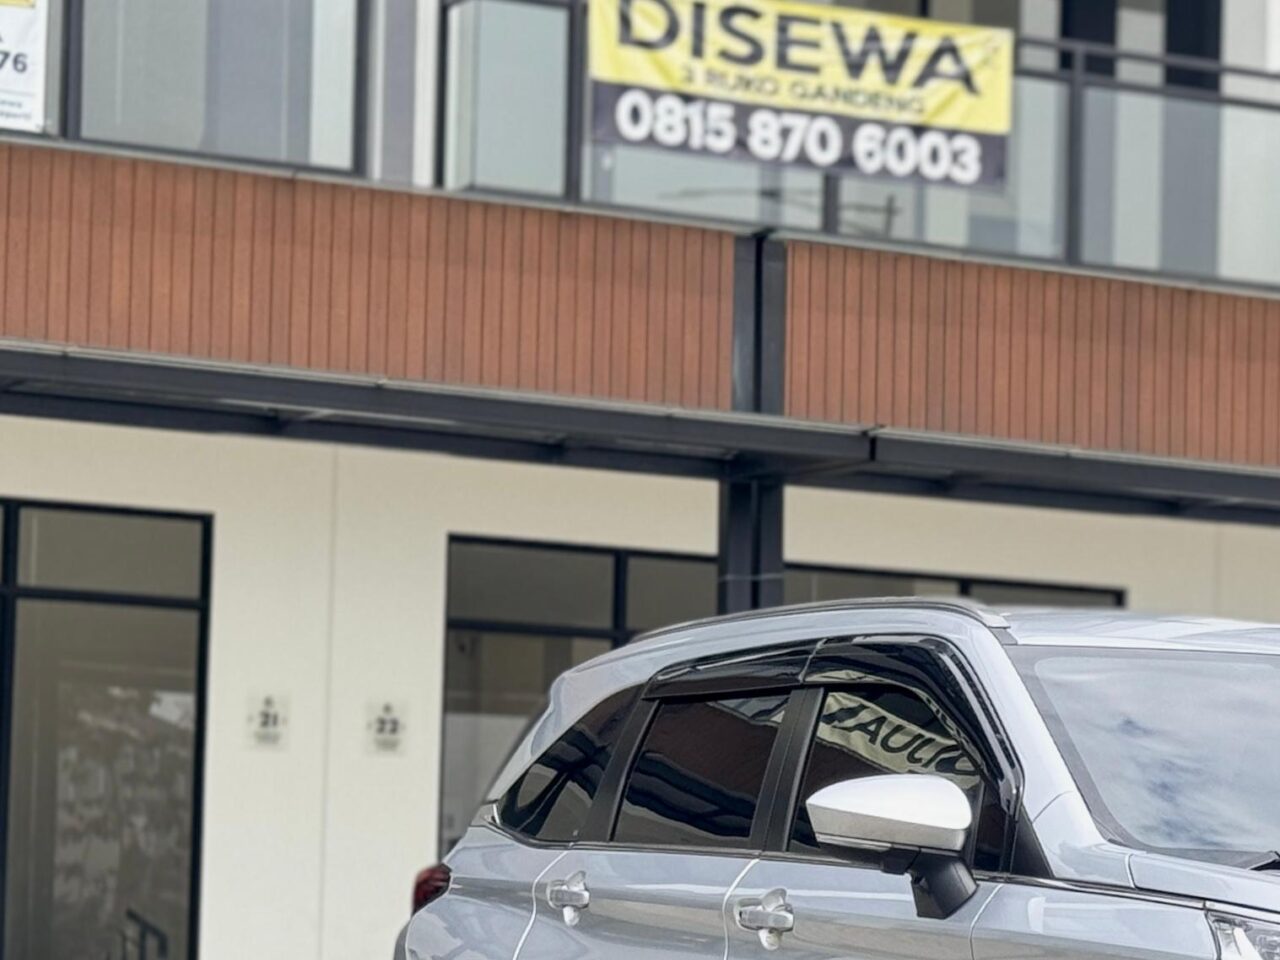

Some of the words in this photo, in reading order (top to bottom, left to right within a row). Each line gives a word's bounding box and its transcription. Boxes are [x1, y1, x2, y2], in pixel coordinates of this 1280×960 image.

[618, 0, 979, 95] DISEWA
[615, 90, 736, 153] 0815
[748, 108, 842, 167] 870
[852, 123, 982, 184] 6003
